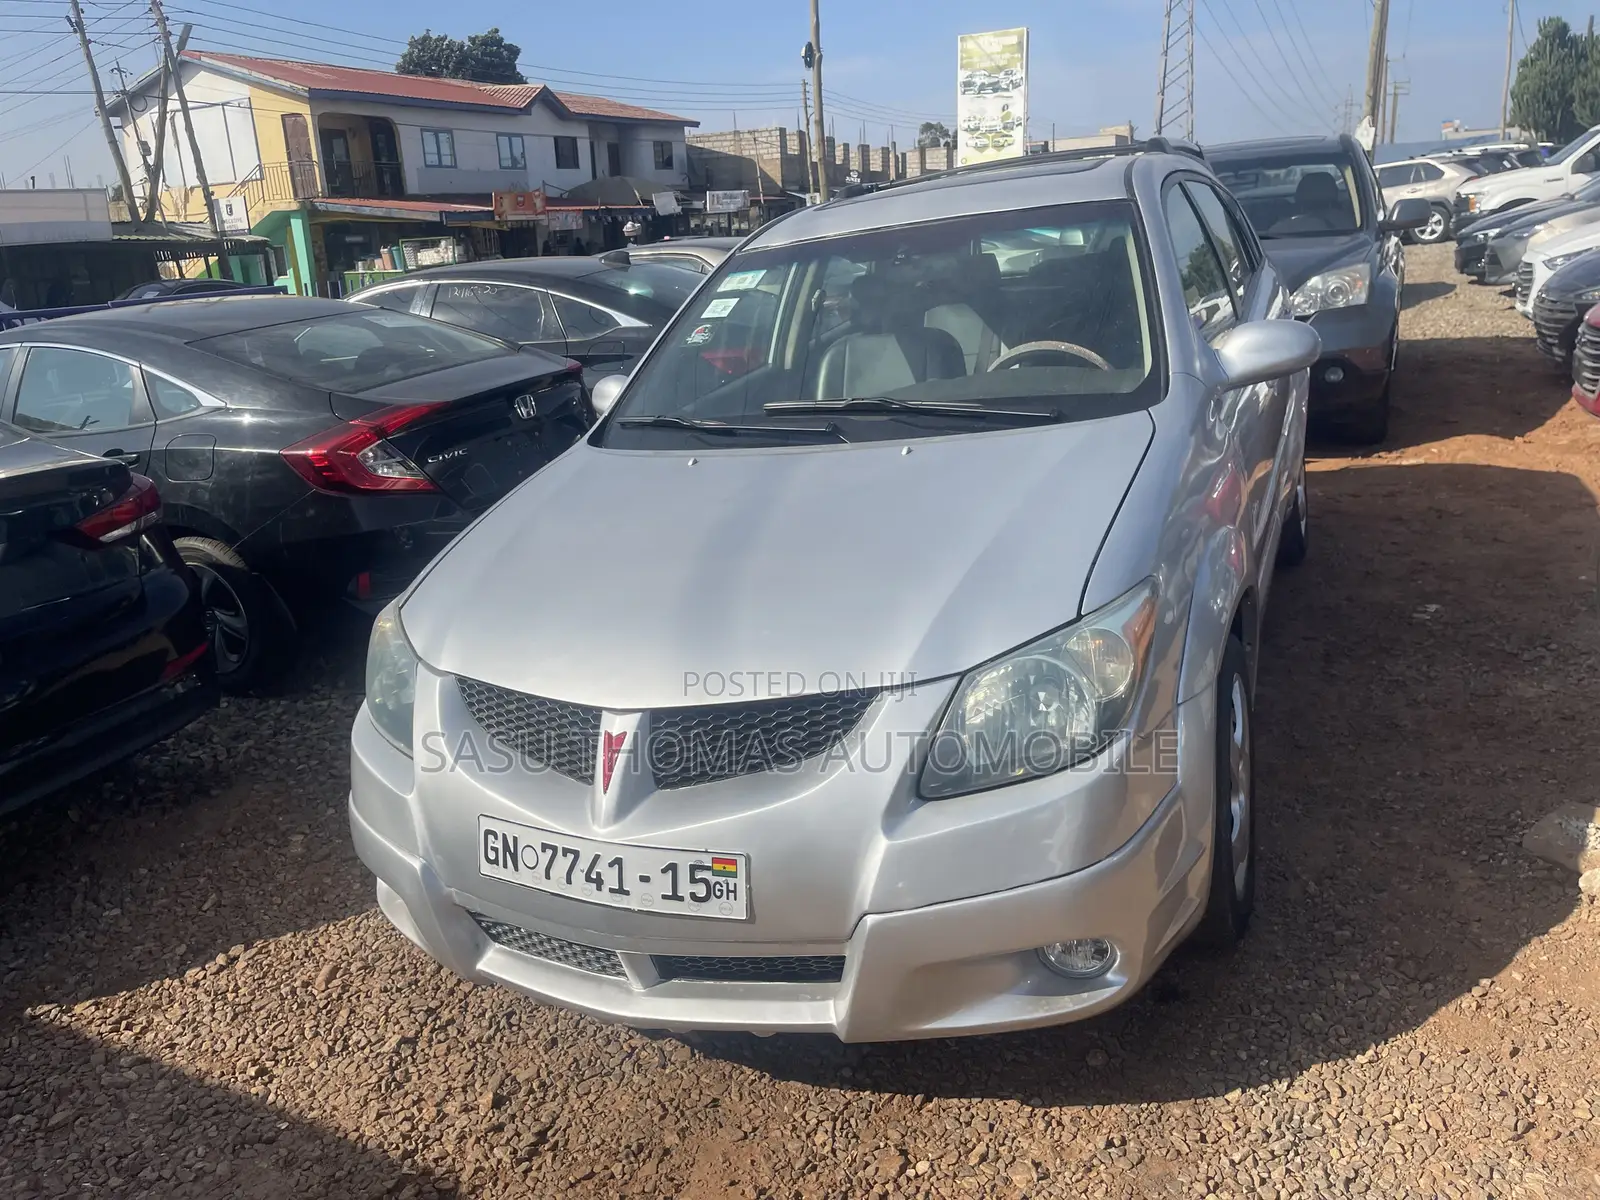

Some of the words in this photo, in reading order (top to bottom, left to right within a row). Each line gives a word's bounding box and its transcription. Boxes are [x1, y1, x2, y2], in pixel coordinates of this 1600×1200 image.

[427, 447, 468, 463] CIVIC
[483, 829, 519, 872] GN
[712, 881, 737, 901] GH
